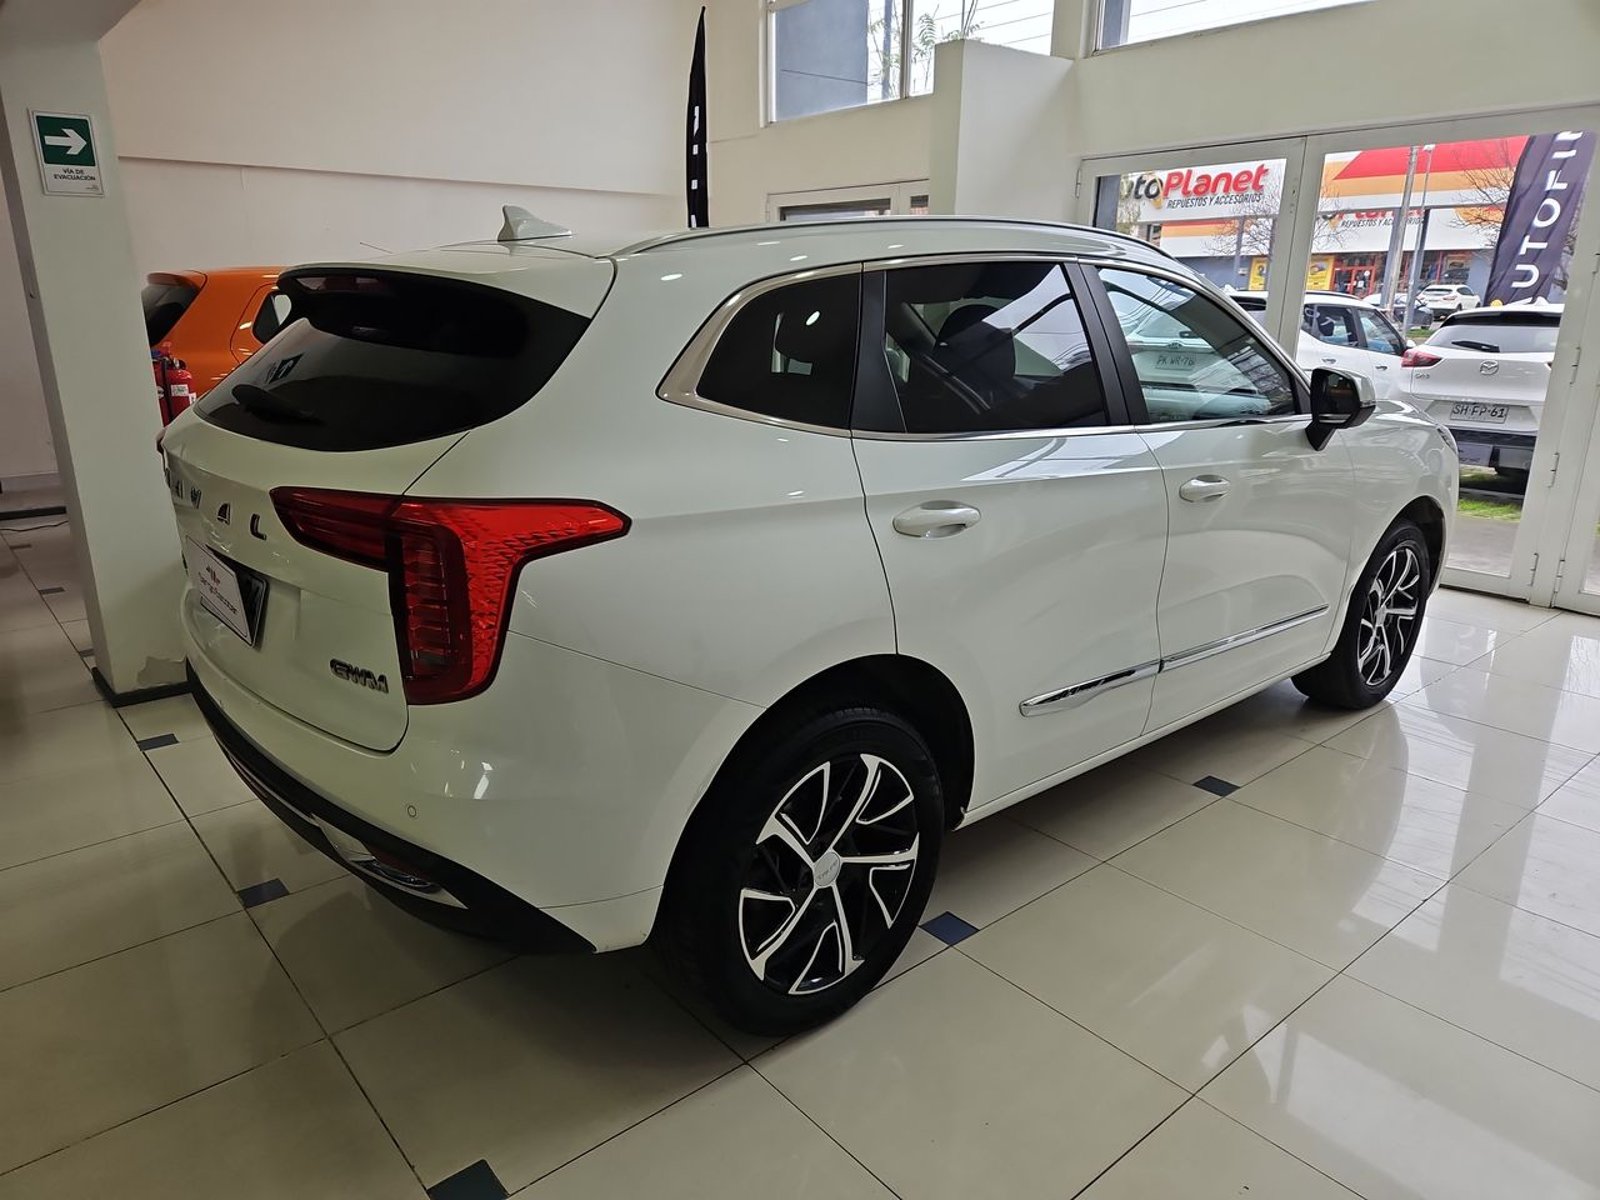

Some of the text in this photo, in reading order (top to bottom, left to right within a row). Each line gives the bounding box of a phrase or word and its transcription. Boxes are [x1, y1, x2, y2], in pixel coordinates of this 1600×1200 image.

[1167, 192, 1262, 209] REPUESTOS Y ACCESORIOS
[1507, 131, 1583, 304] UTOFI
[330, 658, 389, 694] GWM
